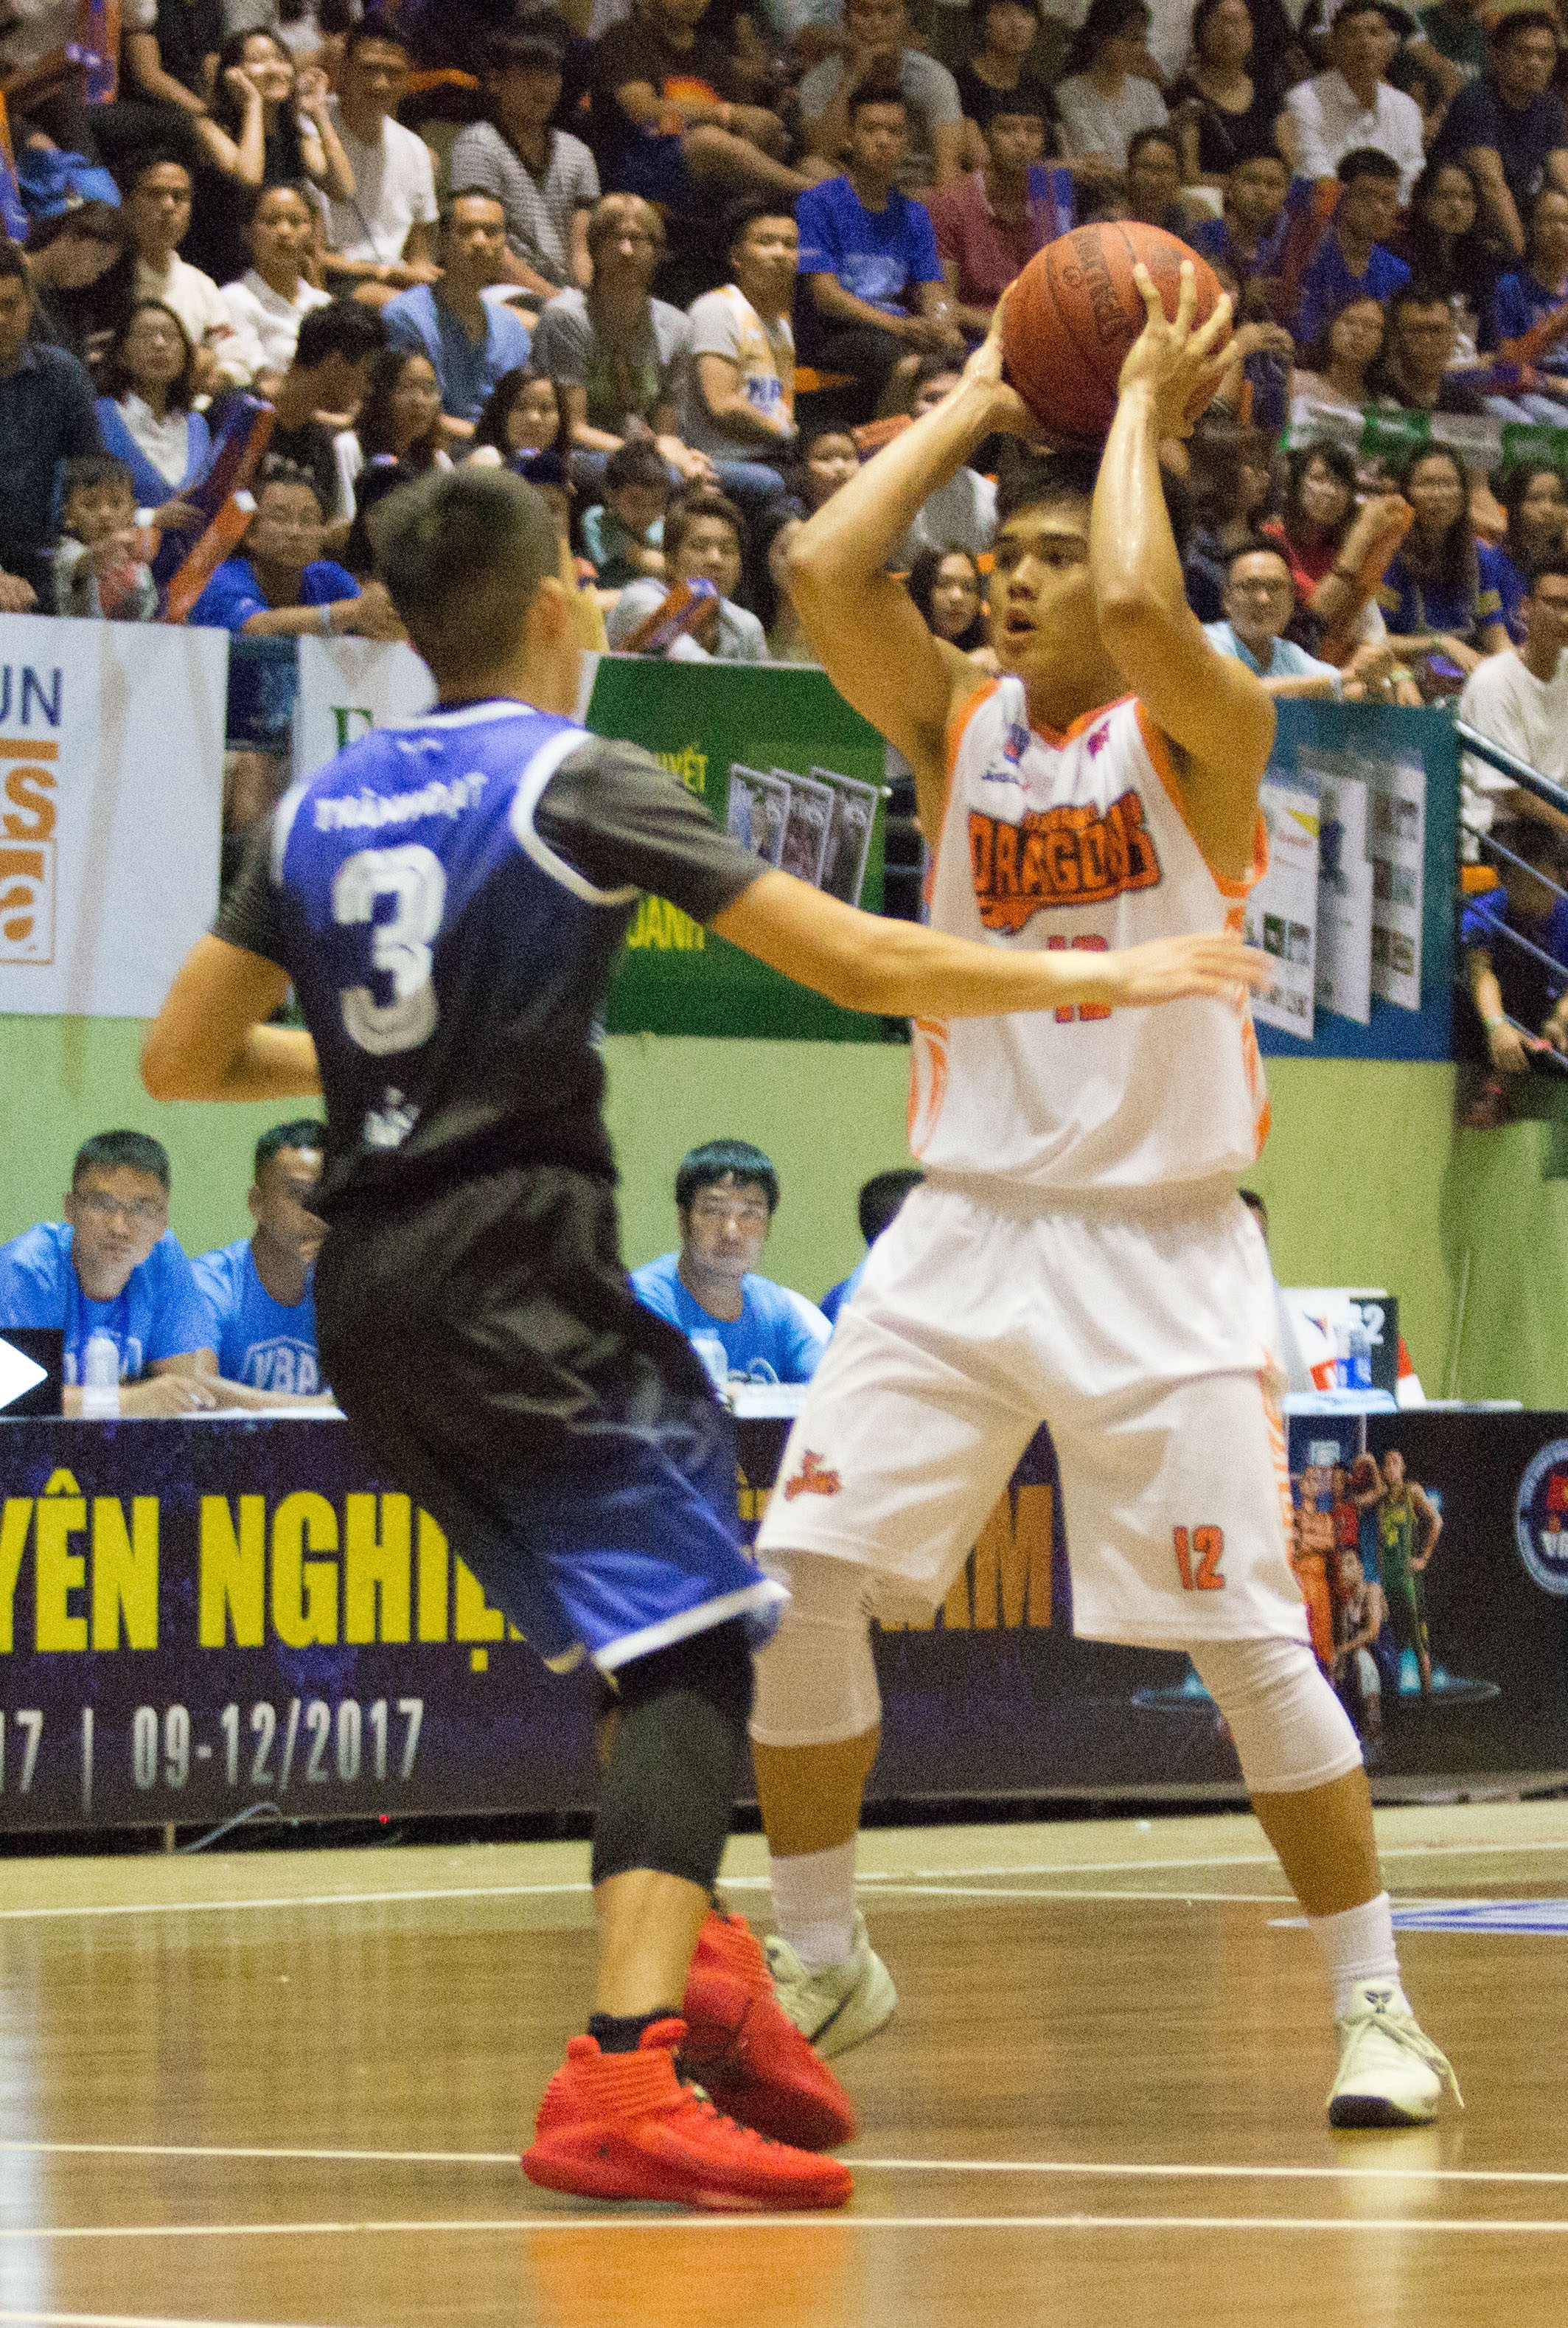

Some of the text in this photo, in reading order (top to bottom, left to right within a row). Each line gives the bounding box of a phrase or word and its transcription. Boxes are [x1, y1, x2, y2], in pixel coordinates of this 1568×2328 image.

[332, 844, 447, 1056] 3
[254, 1347, 318, 1394] VBA
[1173, 1525, 1225, 1590] 12
